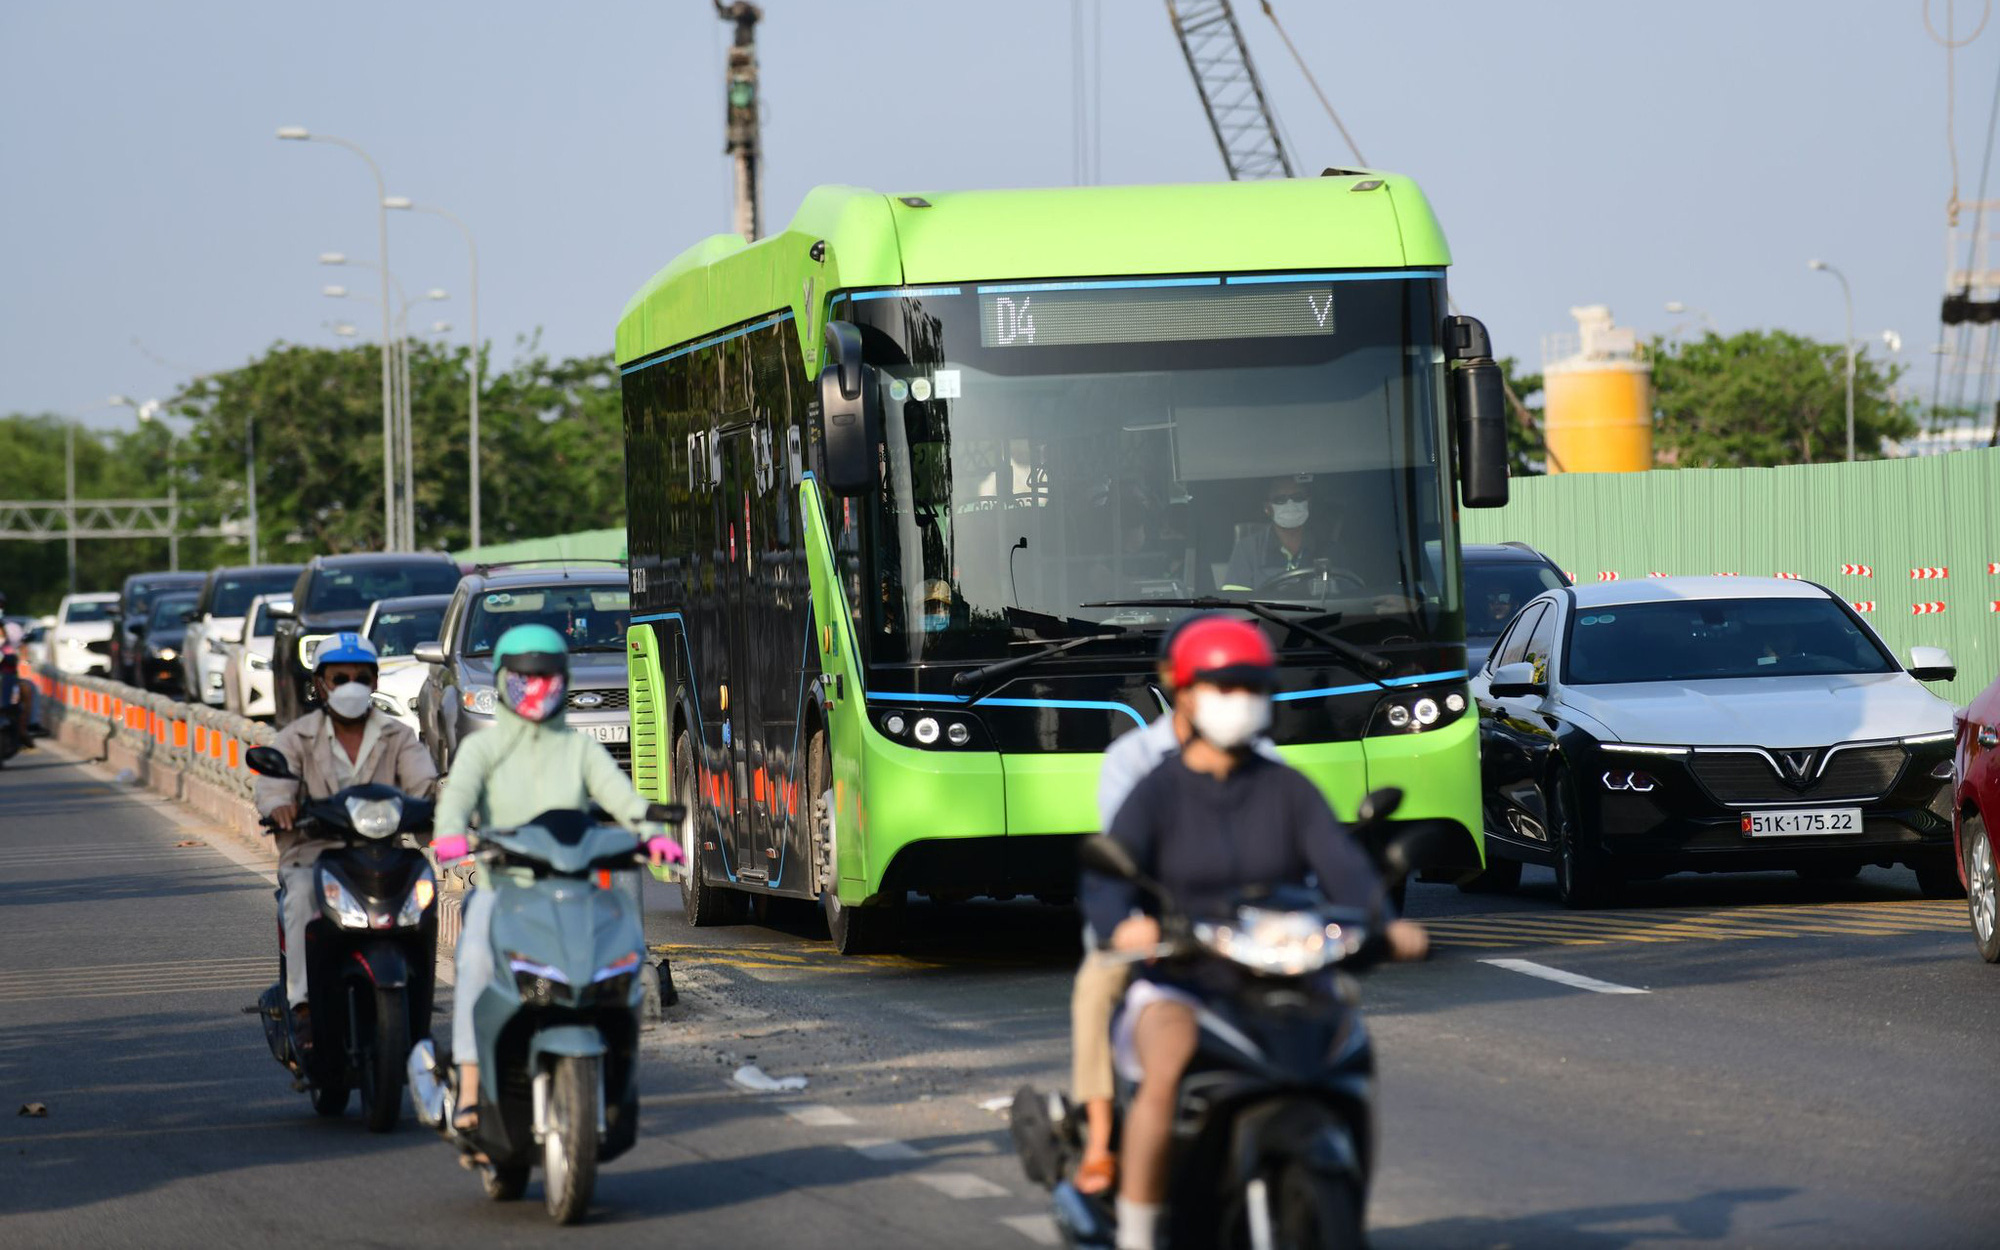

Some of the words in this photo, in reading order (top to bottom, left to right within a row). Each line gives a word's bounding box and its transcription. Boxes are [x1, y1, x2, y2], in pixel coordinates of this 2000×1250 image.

[997, 296, 1036, 345] D4
[1308, 295, 1333, 327] V
[1752, 814, 1853, 833] 51K-175.22
